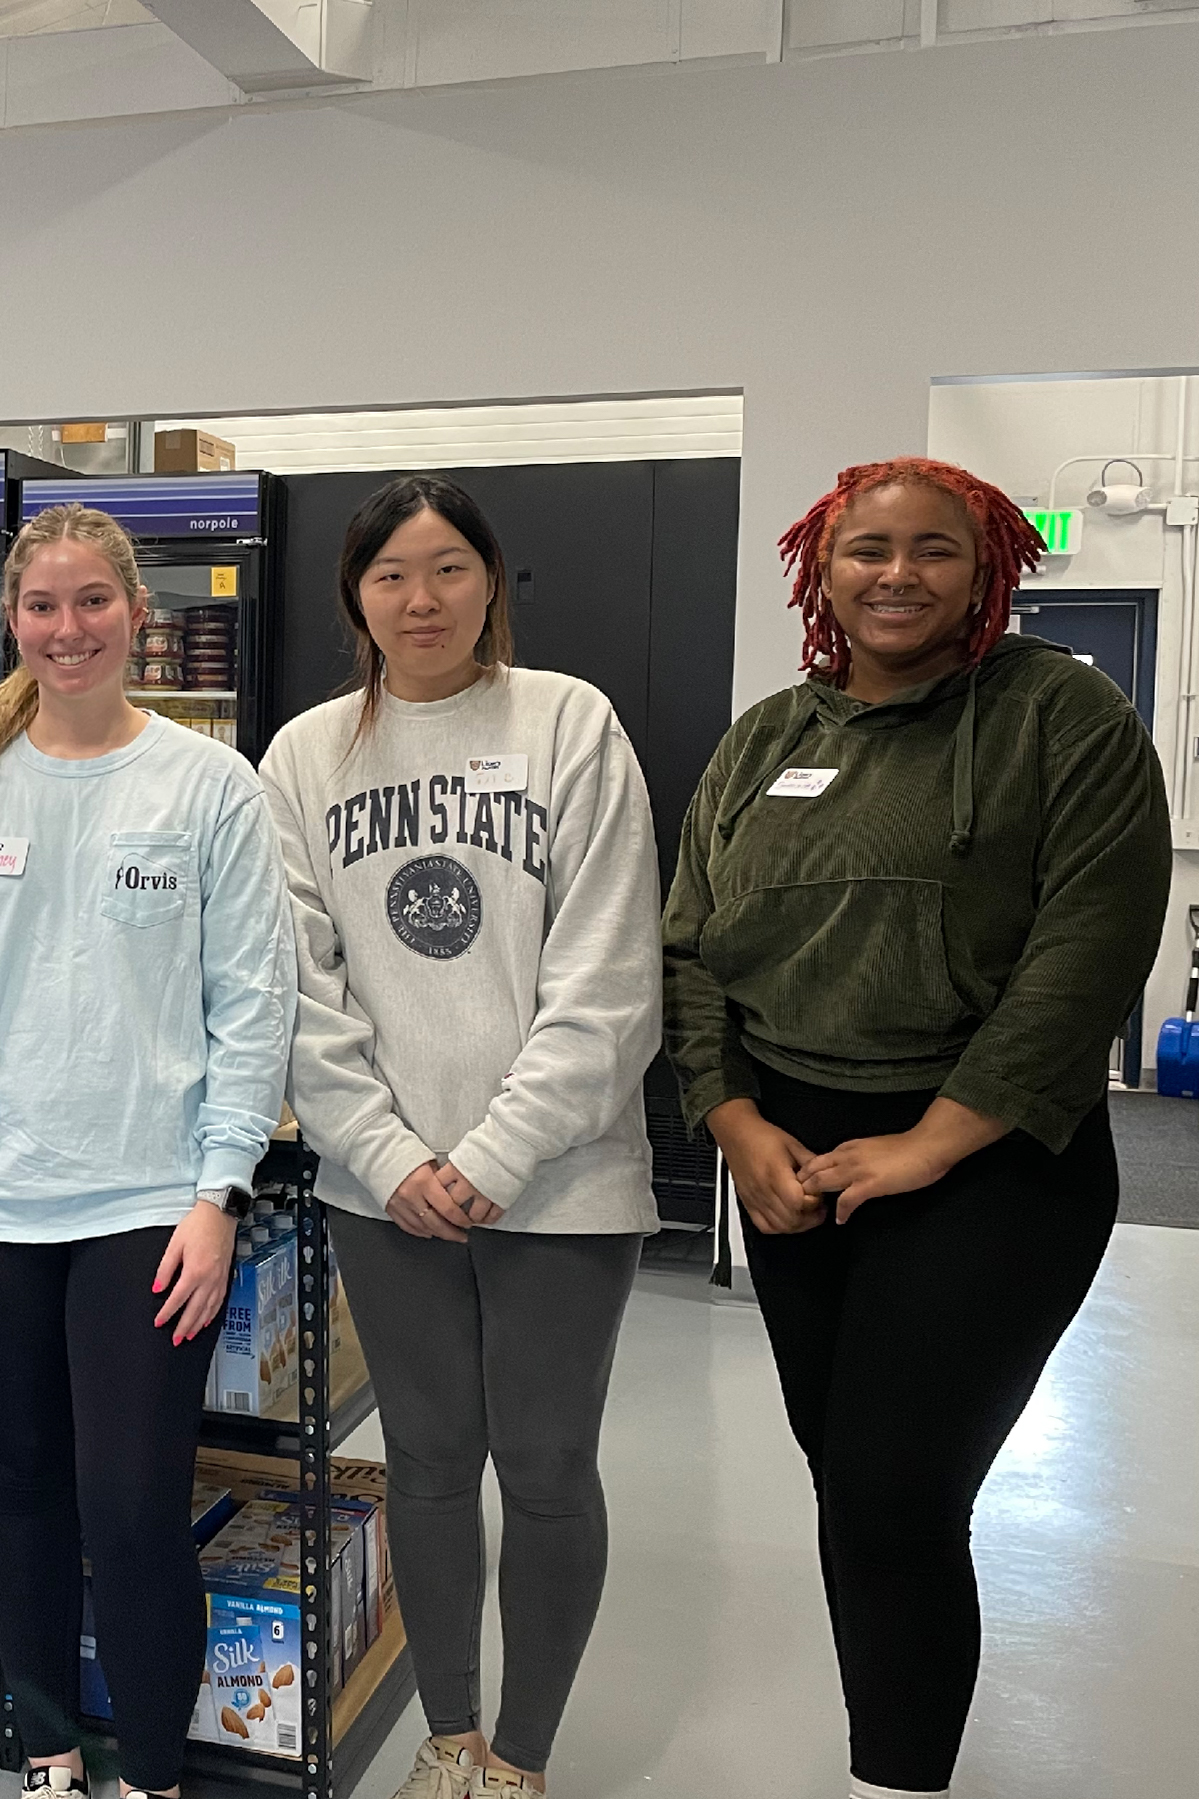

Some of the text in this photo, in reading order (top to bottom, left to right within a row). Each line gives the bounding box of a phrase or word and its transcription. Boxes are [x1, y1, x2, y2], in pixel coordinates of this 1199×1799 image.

[190, 516, 239, 532] norpole
[325, 774, 549, 889] PENN STATE
[435, 860, 462, 876] STATE
[125, 866, 178, 890] Orvis
[223, 1320, 252, 1333] FROM
[227, 1600, 284, 1616] VANILLA ALMOND
[274, 1625, 281, 1636] 6
[213, 1638, 261, 1674] Silk
[217, 1675, 263, 1688] ALMOND
